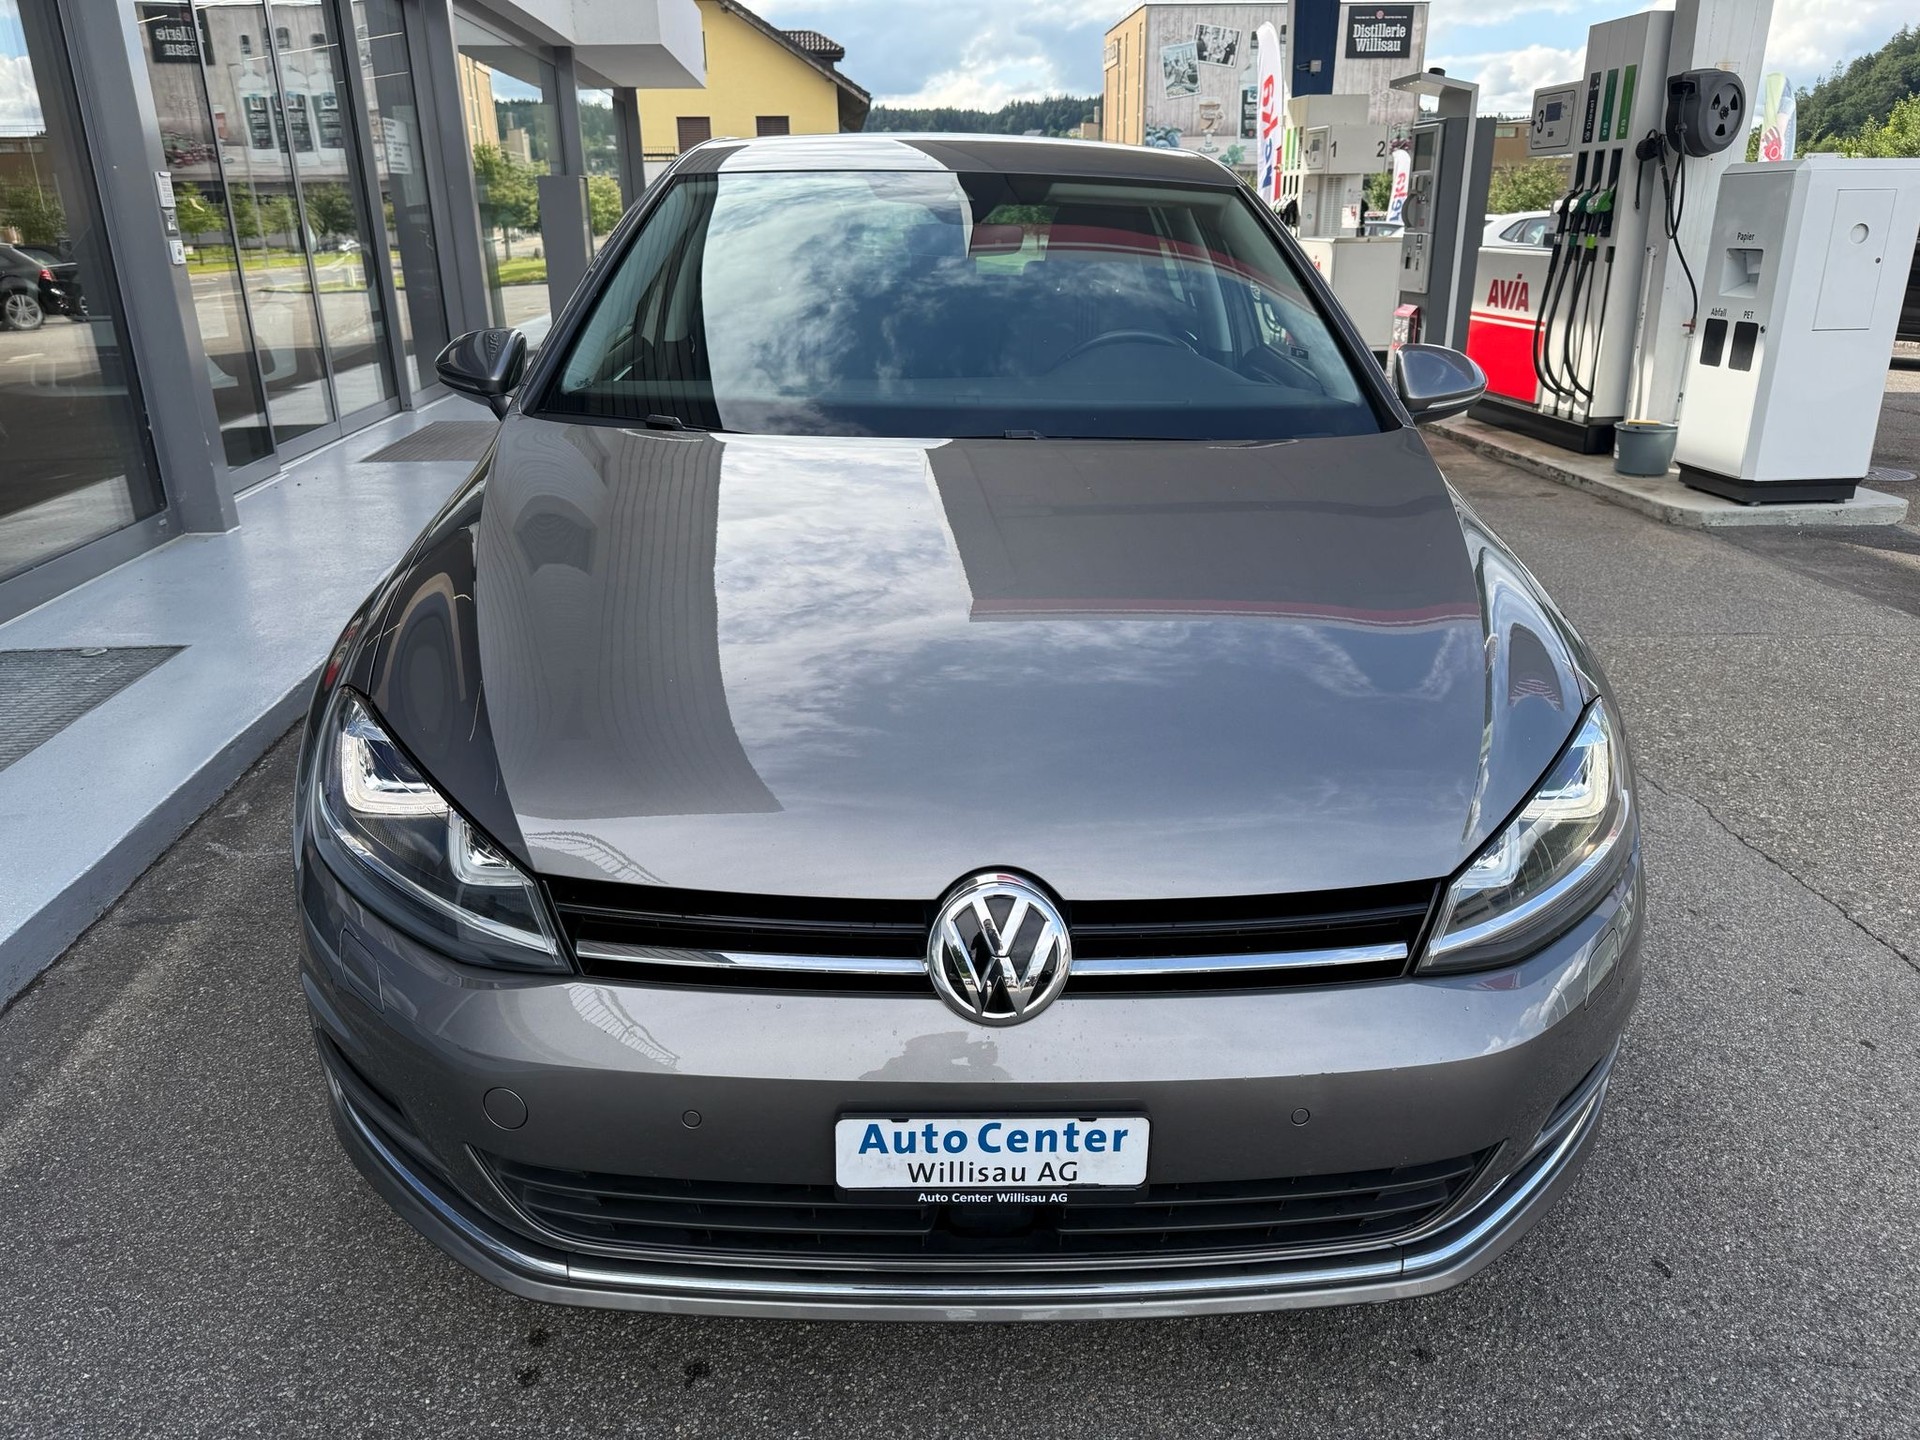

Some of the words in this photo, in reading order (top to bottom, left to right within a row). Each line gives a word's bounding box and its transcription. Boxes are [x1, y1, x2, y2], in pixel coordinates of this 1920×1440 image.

[1353, 23, 1407, 38] Distillerie
[1355, 38, 1401, 52] Willisau
[1536, 109, 1545, 134] 3
[1330, 141, 1337, 158] 1
[1376, 140, 1386, 158] 2
[1736, 232, 1755, 243] Papier
[1711, 307, 1727, 317] Abfall
[1743, 310, 1754, 319] PET
[858, 1123, 968, 1154] Auto
[977, 1122, 1129, 1153] Center
[907, 1161, 1027, 1183] Willisau
[1037, 1161, 1079, 1182] AG
[917, 1192, 948, 1203] Auto
[951, 1192, 993, 1203] Center
[996, 1192, 1046, 1203] Willisau
[1049, 1192, 1068, 1203] AG
